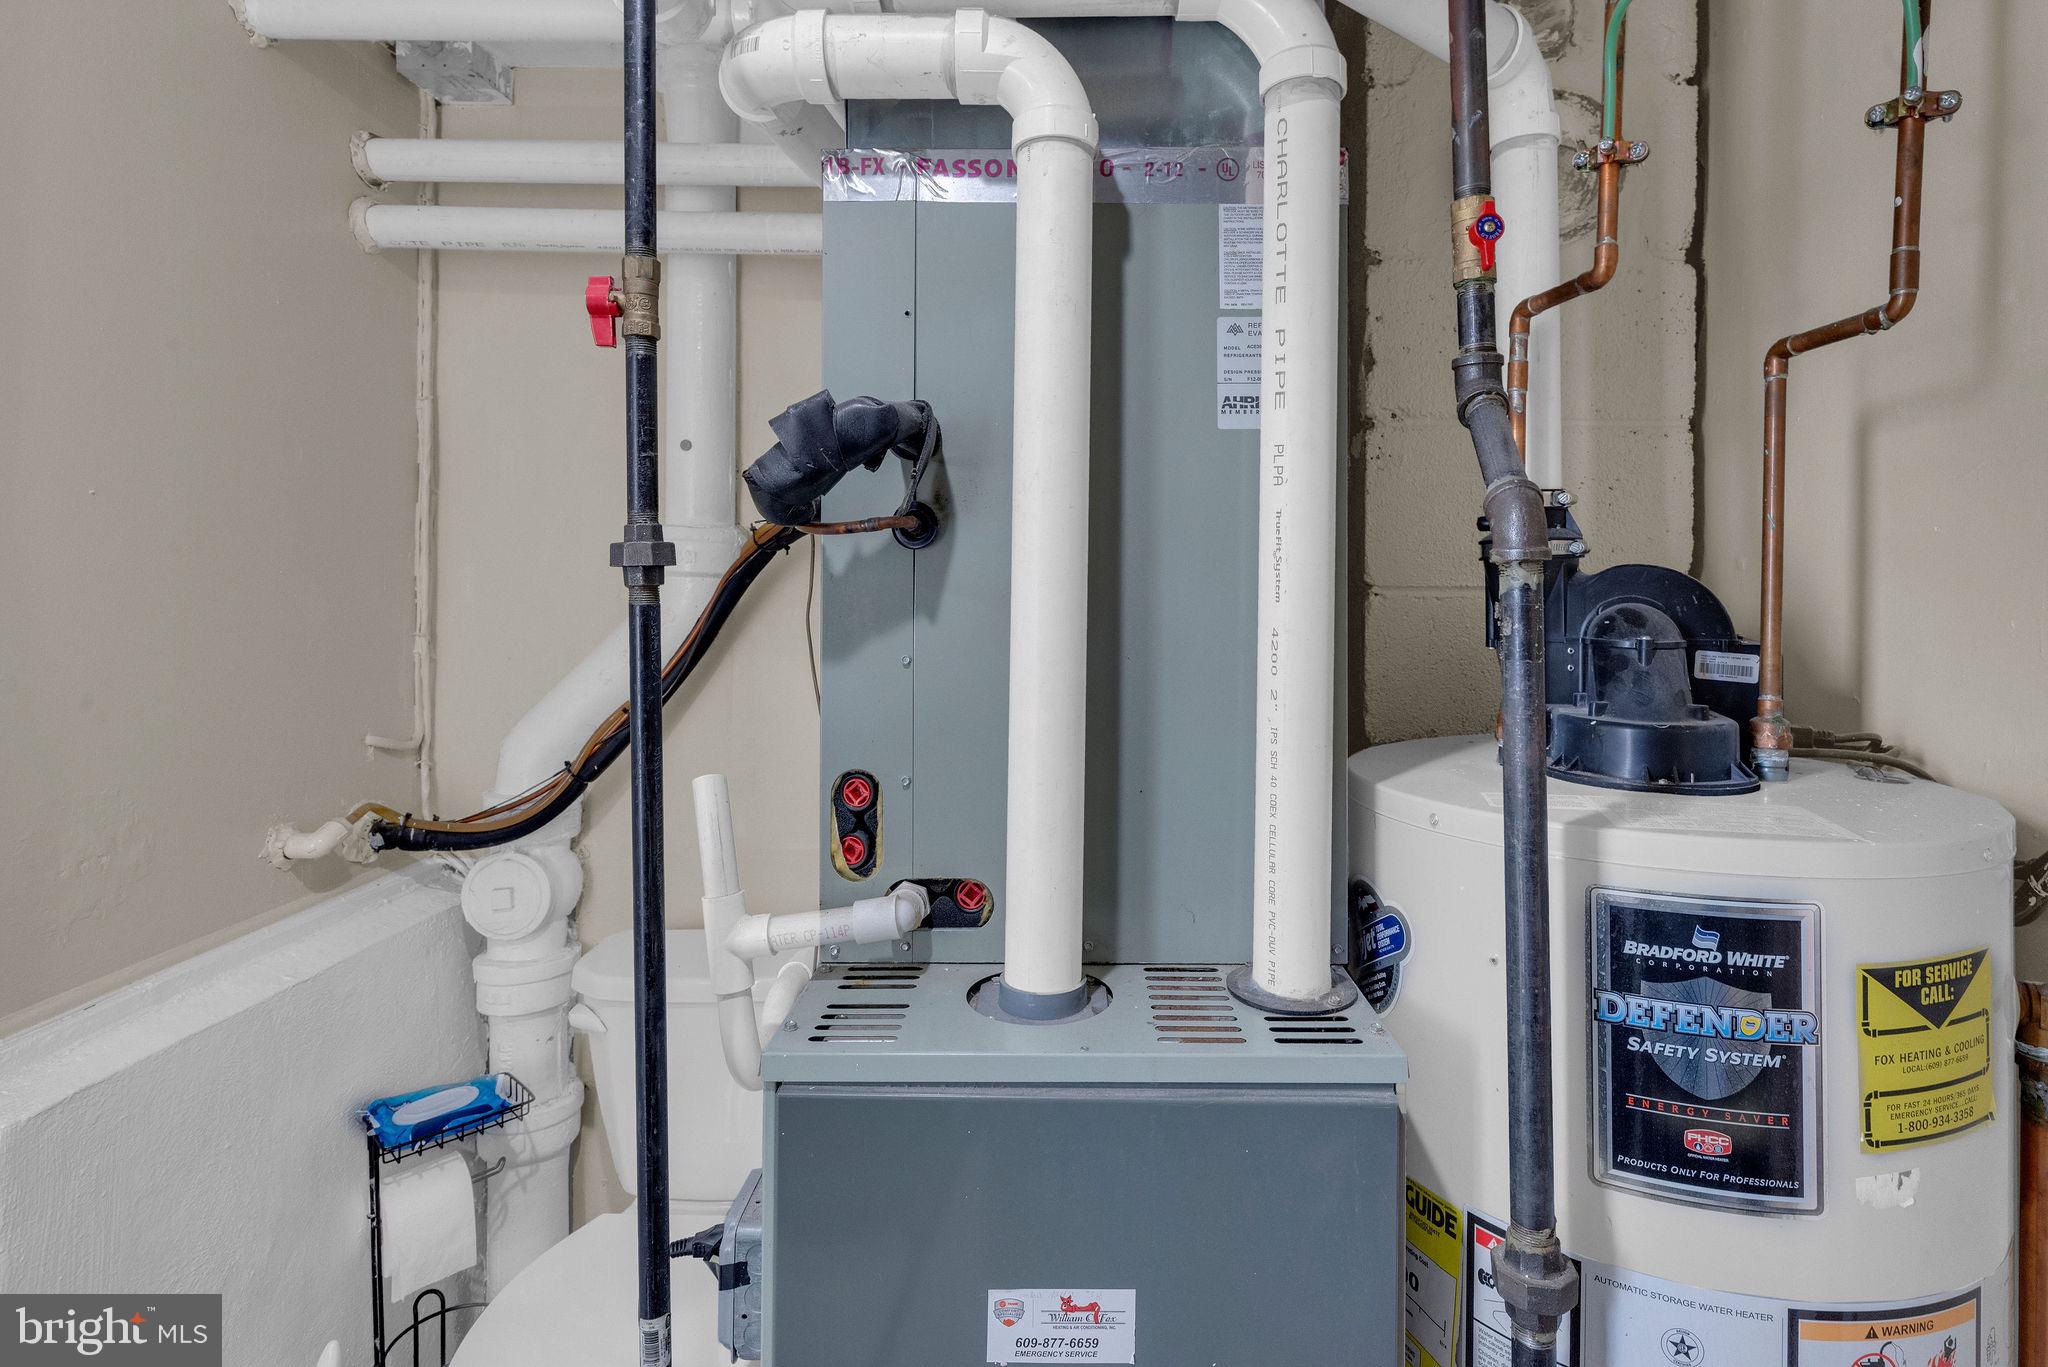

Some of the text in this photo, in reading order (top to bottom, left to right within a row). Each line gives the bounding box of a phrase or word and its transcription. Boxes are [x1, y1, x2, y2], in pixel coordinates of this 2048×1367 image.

[1275, 117, 1288, 306] CHARLOTTE
[1274, 327, 1286, 411] PIPE
[1270, 626, 1279, 677] 4200
[1268, 823, 1277, 875] CELLULAR
[1268, 879, 1276, 906] CORE
[1622, 939, 1722, 965] BRADFORD
[1267, 960, 1276, 987] PIPE
[1635, 958, 1773, 977] CORPORATION
[1894, 957, 1973, 989] FOR SERVICE
[1920, 983, 1955, 1006] CALL:
[1595, 990, 1819, 1045] DEFENDER
[1627, 1036, 1700, 1060] SAFETY
[1874, 1034, 1985, 1066] FOX HEATING & COOLING
[1627, 1095, 1790, 1126] ENERGY SAVER
[1886, 1102, 1901, 1111] FOR
[1903, 1099, 1921, 1109] FAST
[1922, 1098, 1931, 1107] 24
[1967, 1084, 1980, 1096] DAYS
[1890, 1107, 1933, 1121] EMERGENCY
[1687, 1132, 1730, 1146] PHCC
[1617, 1154, 1800, 1190] PRODUCTS ONLY FOR PROFESSIONALS
[1406, 1184, 1458, 1240] GUIDE
[1593, 1273, 1774, 1322] AUTOMATIC STORAGE WATER HEATER
[1048, 1312, 1083, 1322] William
[1881, 1320, 1935, 1337] WARNING
[1014, 1350, 1099, 1358] EMERGENCY SERVICE
[1015, 1337, 1099, 1349] 609-877-6659
